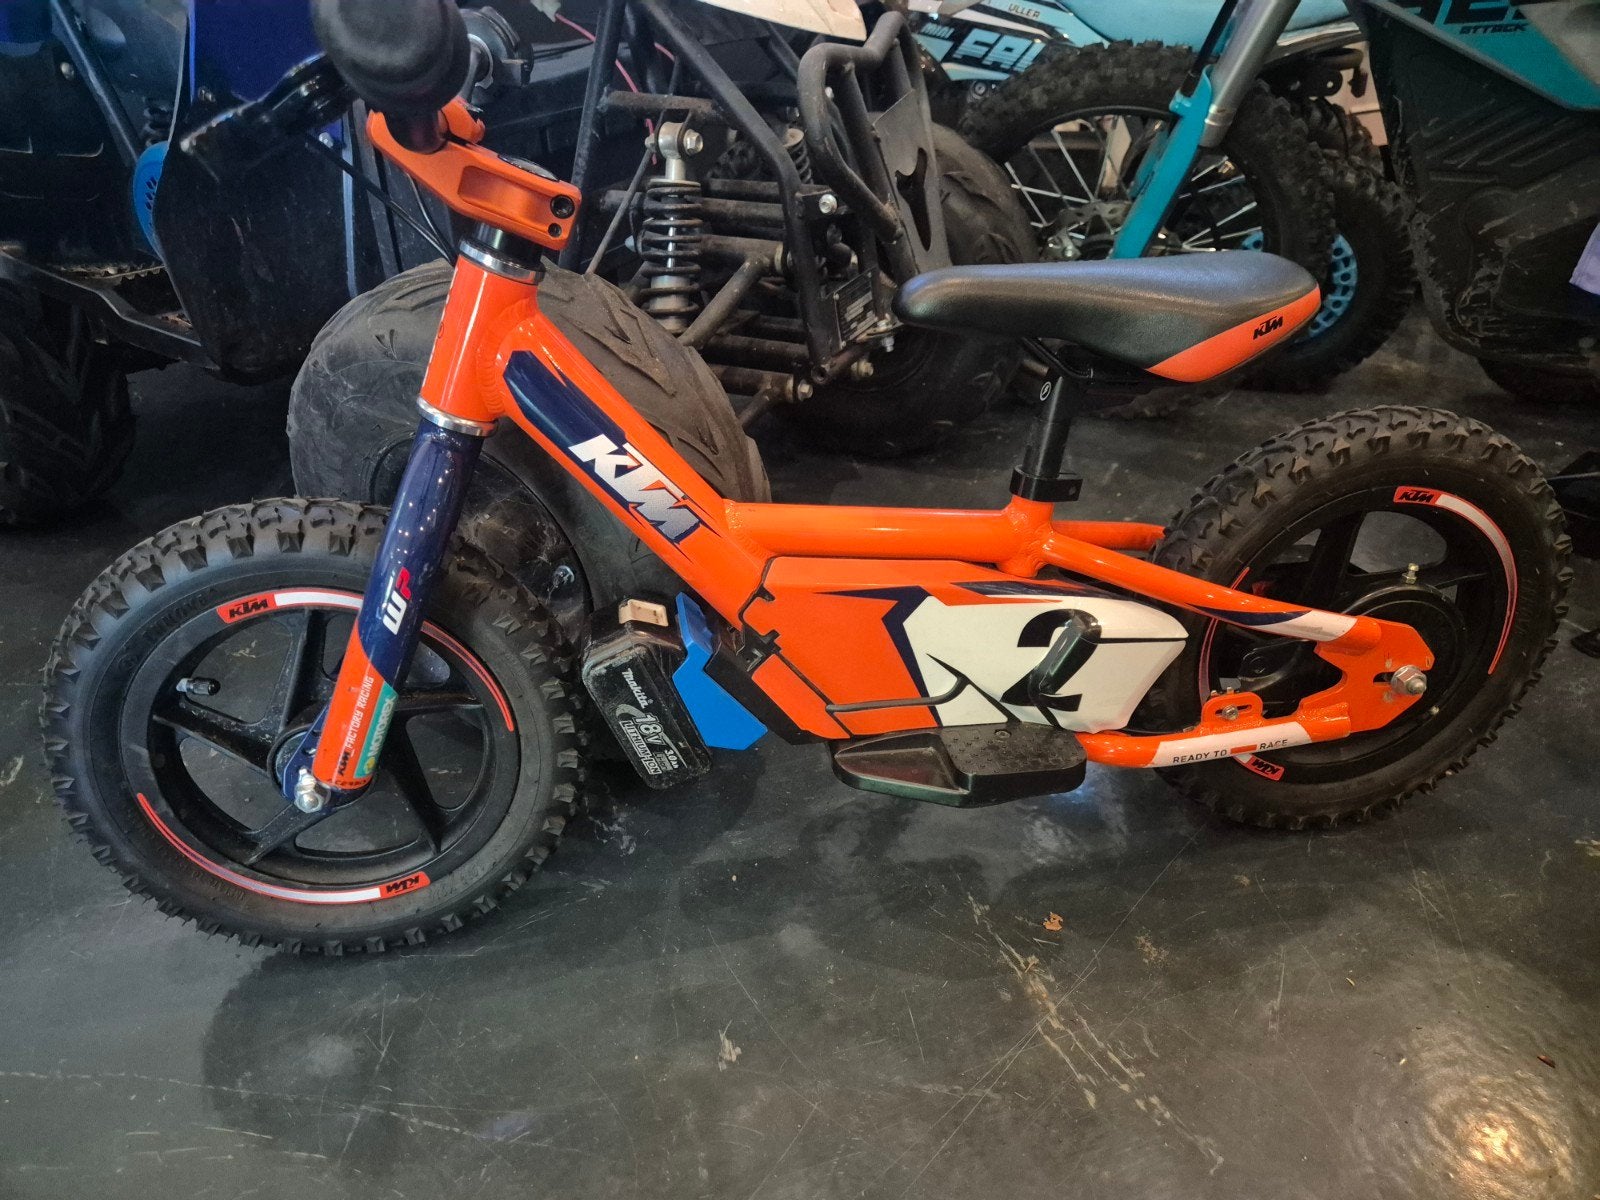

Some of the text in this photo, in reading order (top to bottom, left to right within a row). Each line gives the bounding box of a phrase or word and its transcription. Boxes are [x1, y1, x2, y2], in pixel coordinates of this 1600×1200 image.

[1252, 315, 1284, 340] KTM
[568, 433, 700, 541] KTM
[1398, 489, 1435, 503] KTM
[229, 598, 268, 619] KTM
[382, 566, 412, 636] WP
[1000, 608, 1100, 712] 2
[344, 710, 364, 749] FACTORY
[357, 675, 375, 709] RACING
[367, 695, 397, 757] MOTOREX
[634, 713, 667, 746] 18V
[620, 720, 662, 775] LITHIUM-ION
[1172, 739, 1289, 764] READY TO RACE
[1251, 758, 1279, 775] KTM
[386, 875, 420, 894] KTM
